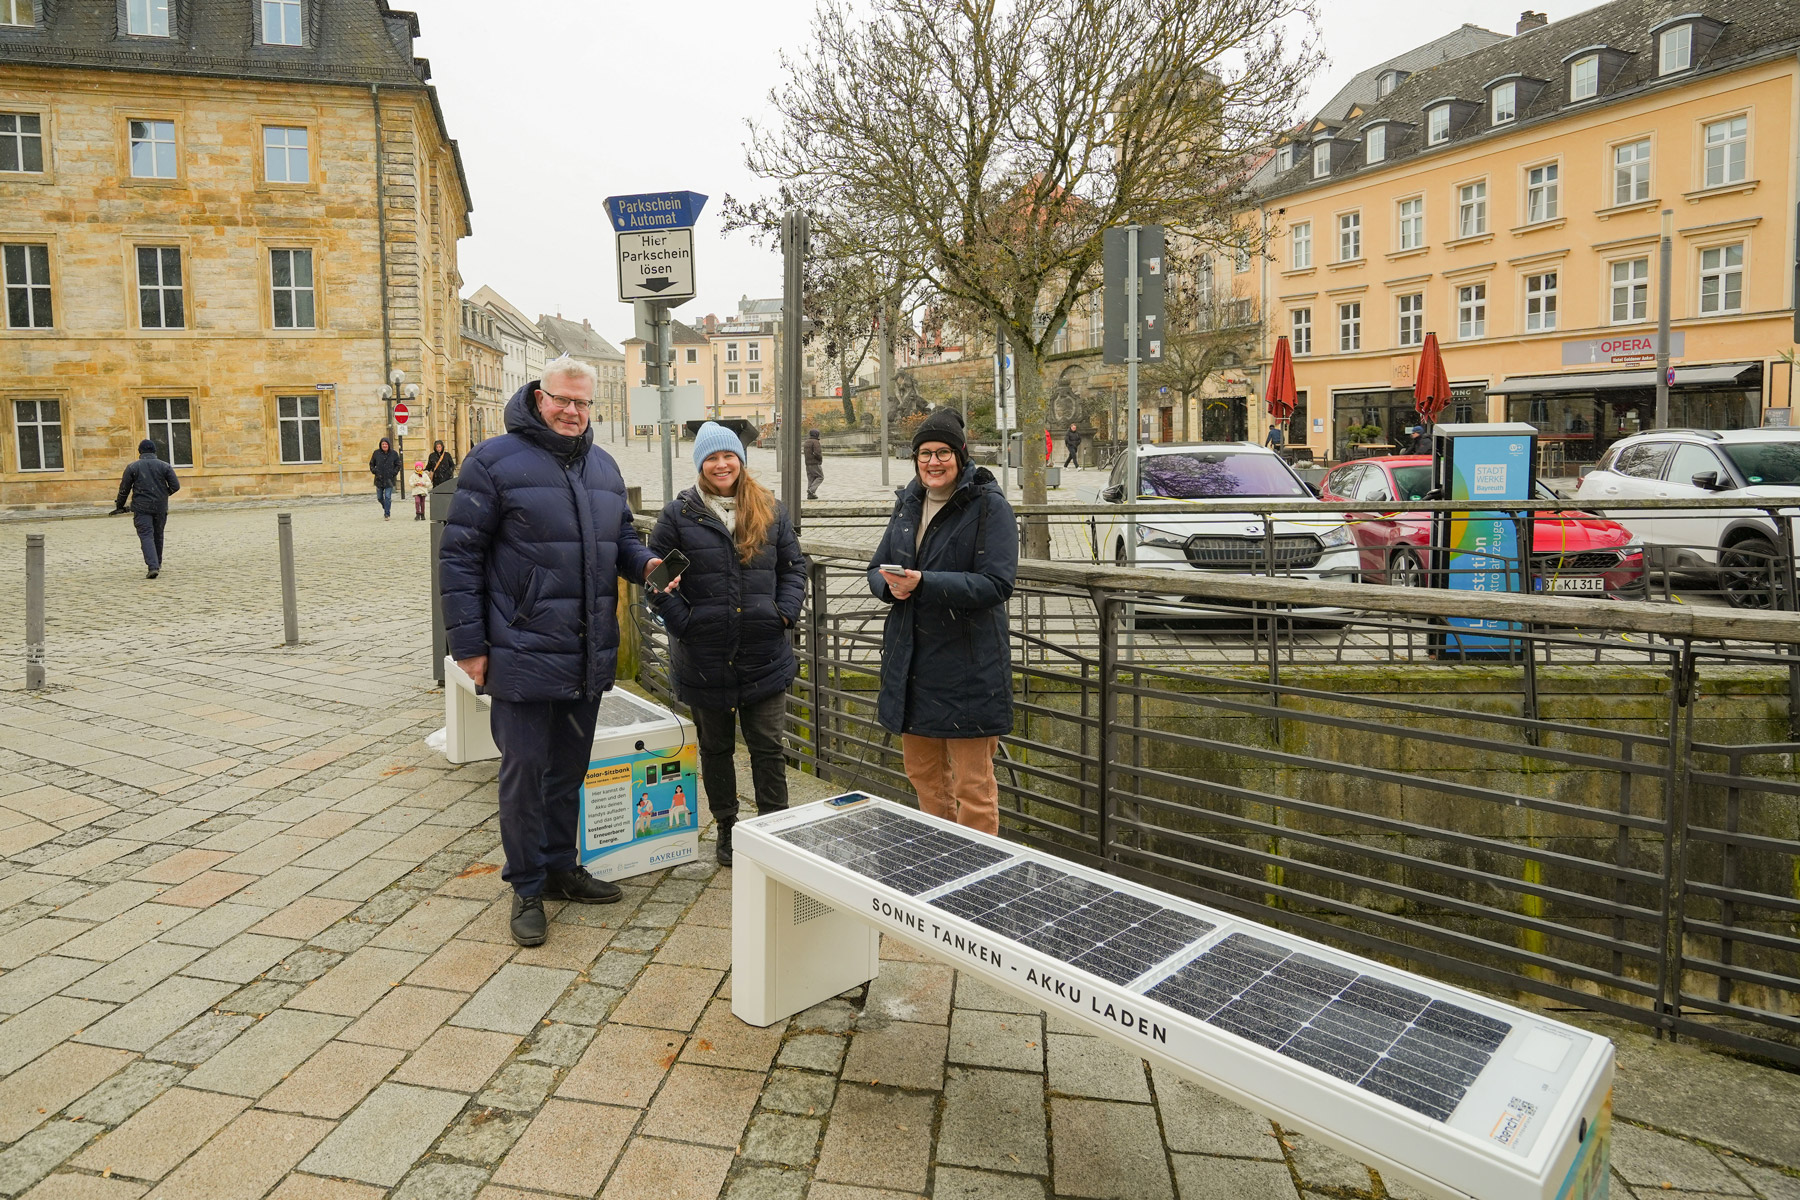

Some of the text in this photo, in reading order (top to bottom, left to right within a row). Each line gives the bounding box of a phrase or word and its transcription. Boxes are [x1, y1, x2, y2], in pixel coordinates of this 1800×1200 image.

[619, 197, 681, 213] Parkschein
[630, 211, 677, 227] Automat
[642, 235, 667, 247] Hier
[622, 248, 689, 262] Parkschein
[640, 264, 672, 275] lösen
[1601, 338, 1652, 352] OPERA
[1477, 466, 1504, 474] STADT
[1477, 475, 1504, 483] WERKE
[1477, 484, 1504, 492] Bayreuth
[586, 767, 630, 779] Solar-Sitzbank
[588, 824, 613, 832] kostenfrei
[650, 848, 692, 864] BAYREUTH
[872, 897, 924, 932] SONNE
[932, 924, 1002, 969] TANKEN
[1026, 968, 1082, 1003] AKKU
[1092, 996, 1167, 1044] LADEN
